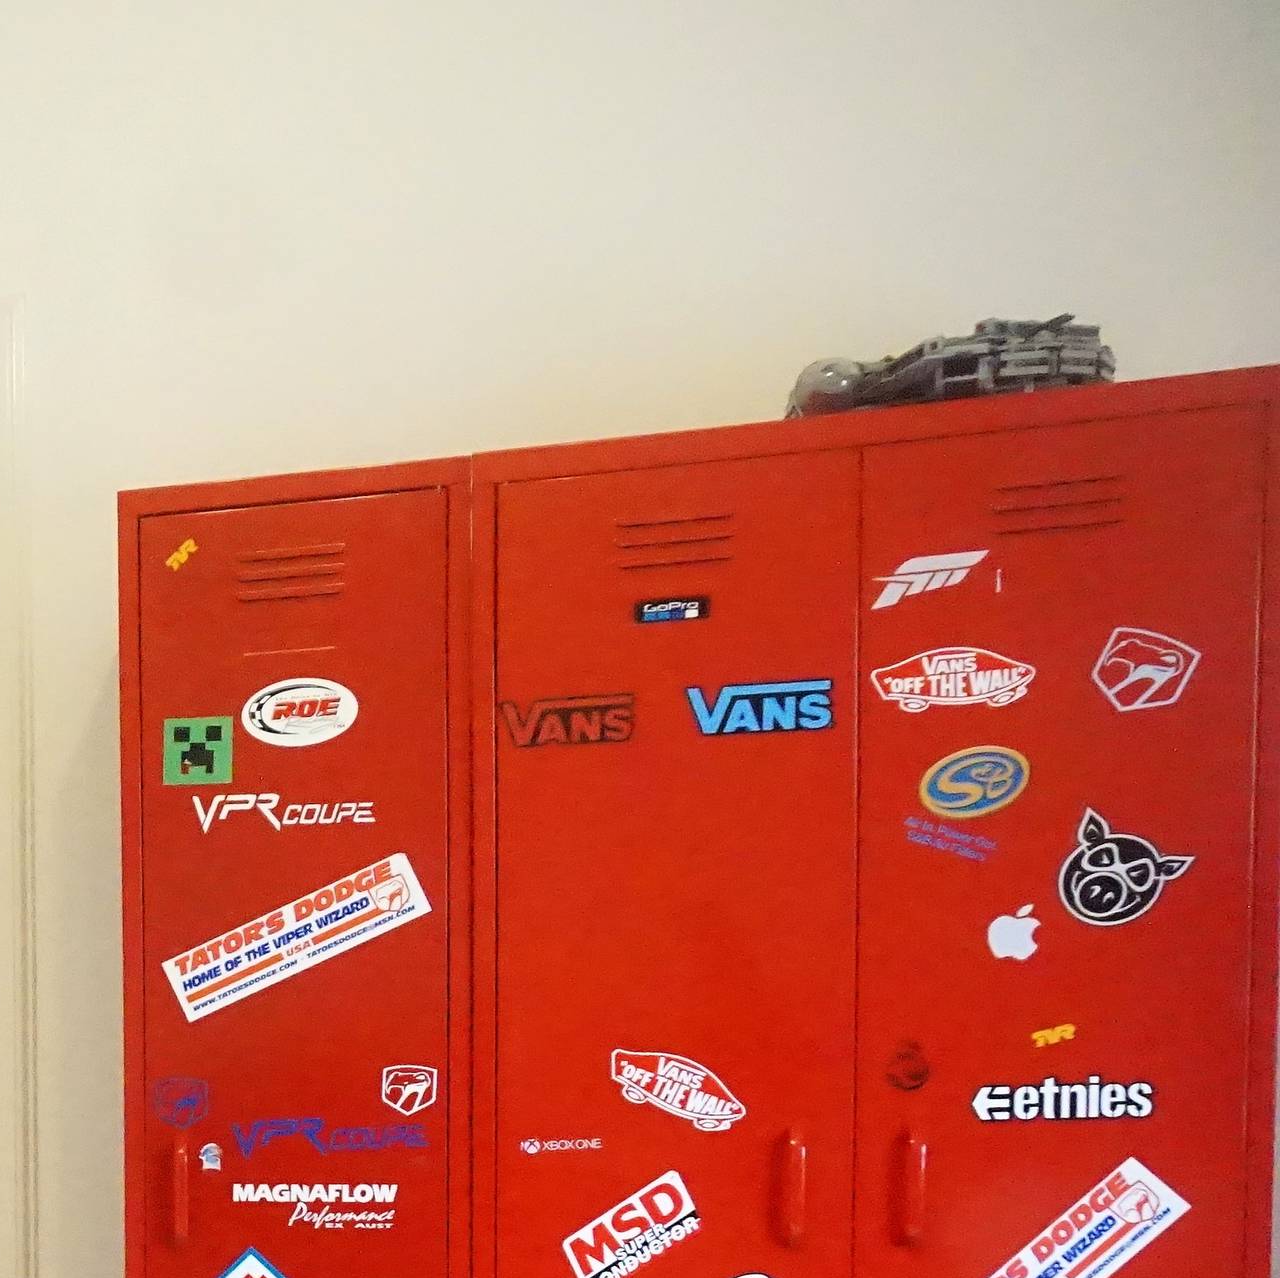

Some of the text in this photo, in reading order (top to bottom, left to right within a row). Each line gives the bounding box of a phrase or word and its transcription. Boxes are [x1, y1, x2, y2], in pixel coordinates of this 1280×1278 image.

[643, 601, 699, 613] GoPro
[921, 653, 977, 675] VANS
[928, 673, 968, 697] THE
[500, 693, 634, 747] VANS
[686, 679, 833, 735] VANS
[192, 793, 376, 834] VPR COUPE
[294, 861, 395, 923] DODGE
[182, 896, 370, 992] HOME OF THE VIPER WIZARD
[286, 940, 311, 958] USA
[657, 1056, 707, 1089] VANS
[652, 1075, 690, 1108] THE
[325, 1123, 430, 1151] COUPE
[542, 1138, 603, 1151] XBOX ONE
[232, 1184, 398, 1203] MAGNAFLOW
[288, 1201, 395, 1229] Performance
[570, 1183, 683, 1276] MSD
[1031, 1171, 1132, 1262] DODGE
[615, 1224, 665, 1260] SUPER
[1061, 1215, 1117, 1264] WIZARD
